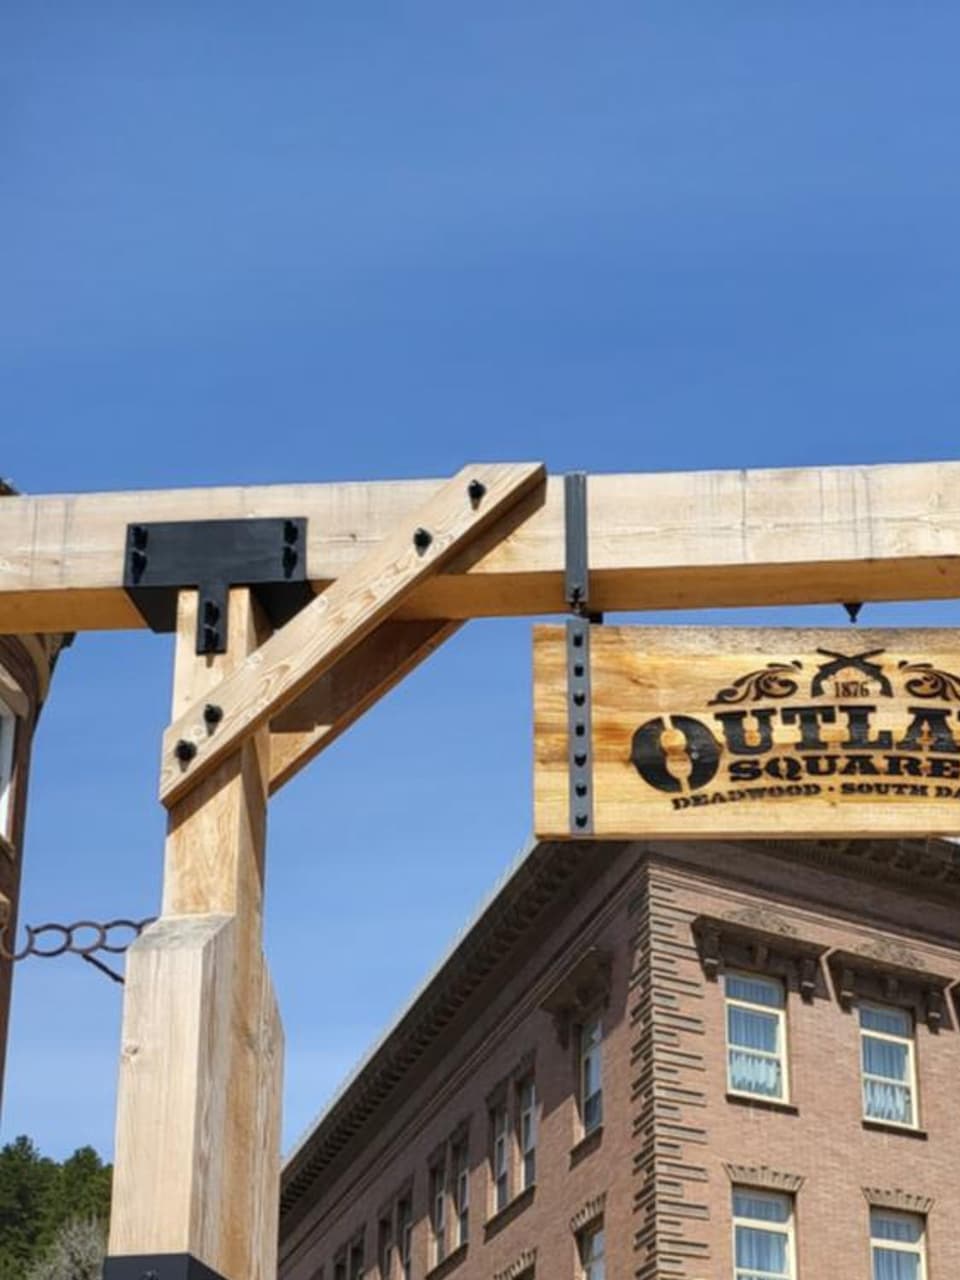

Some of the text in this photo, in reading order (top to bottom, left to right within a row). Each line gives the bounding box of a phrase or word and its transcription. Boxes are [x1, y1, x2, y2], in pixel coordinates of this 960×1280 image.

[833, 680, 871, 698] 1876
[728, 755, 960, 782] SQUARE
[671, 783, 822, 811] DEADWOOD
[841, 783, 928, 798] SOUTH
